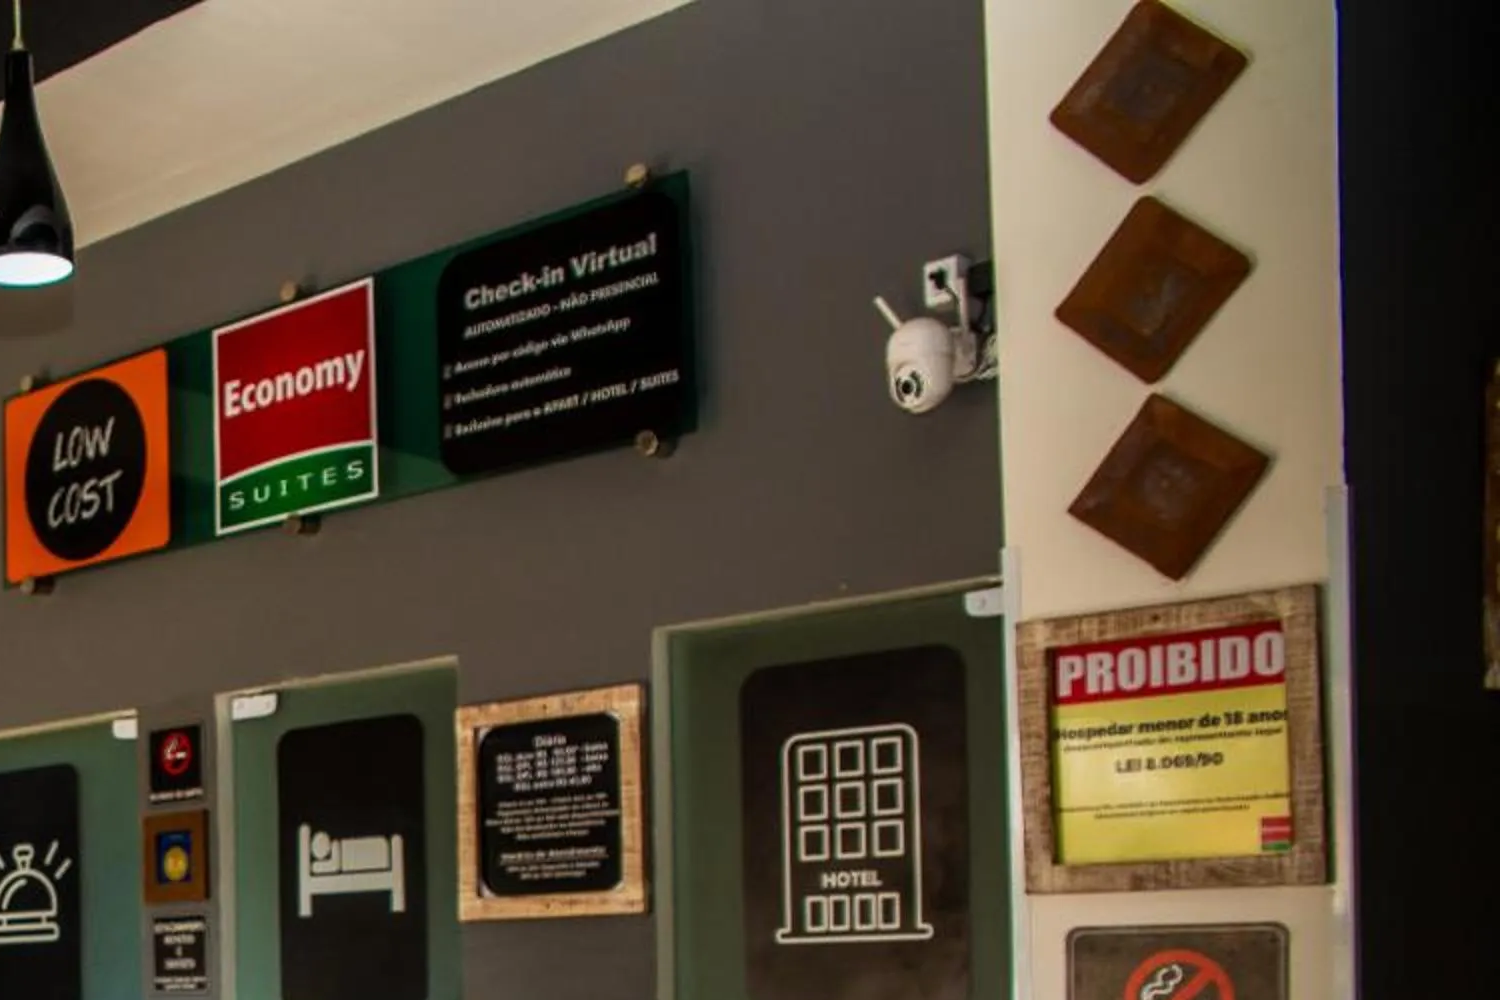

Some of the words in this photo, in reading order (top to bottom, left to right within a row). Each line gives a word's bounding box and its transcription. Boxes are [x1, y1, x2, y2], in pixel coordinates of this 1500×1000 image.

[465, 265, 565, 310] Check-in
[569, 232, 657, 277] Virtual
[463, 304, 551, 339] AUTOMATIZADO
[570, 317, 631, 342] WhatsApp
[223, 349, 366, 419] Economy
[590, 383, 628, 403] HOTEL
[52, 416, 116, 472] LOW
[47, 469, 124, 528] COST
[228, 459, 365, 511] SUITES
[1055, 631, 1286, 699] PROIBIDO
[1199, 713, 1222, 728] de
[821, 870, 884, 888] HOTEL
